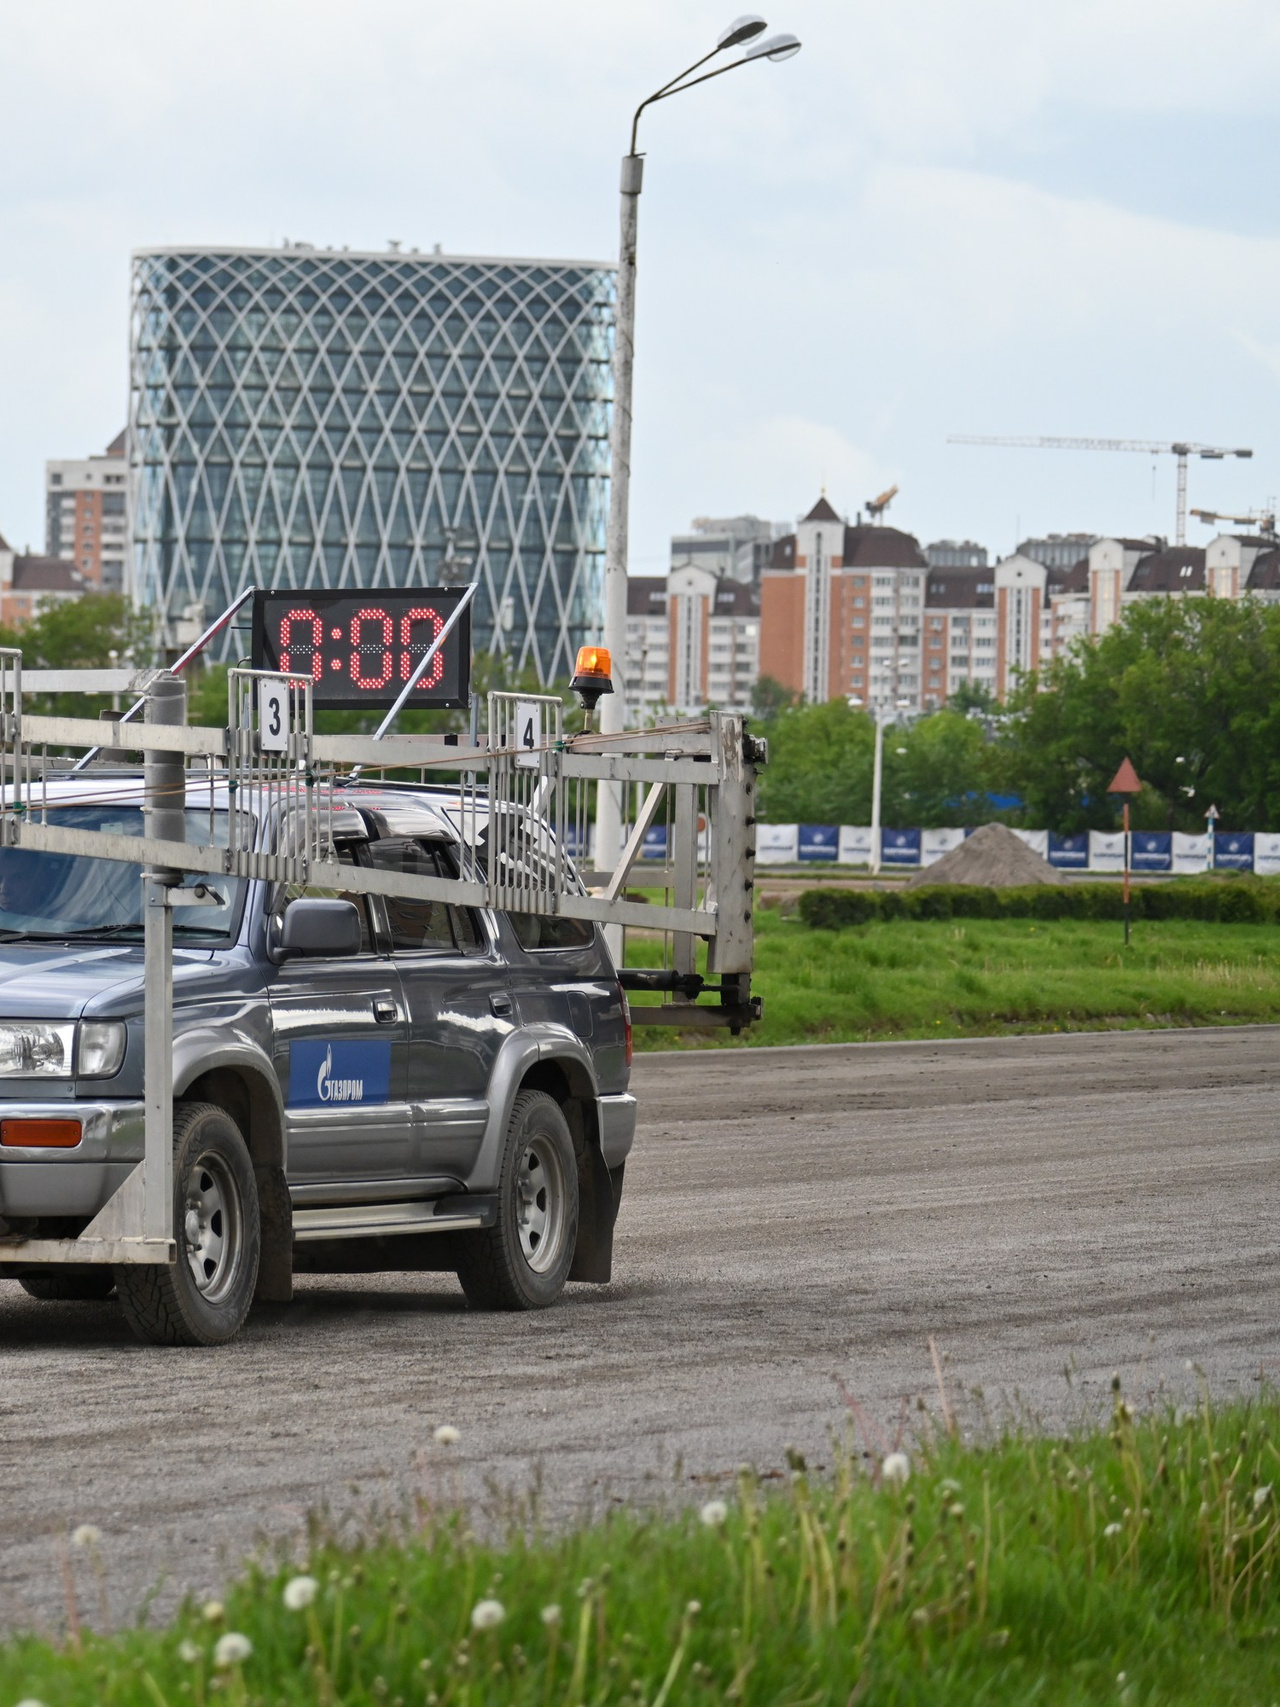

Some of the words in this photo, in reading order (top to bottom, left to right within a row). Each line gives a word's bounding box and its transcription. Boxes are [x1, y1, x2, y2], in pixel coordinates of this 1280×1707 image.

[280, 608, 444, 689] 0:00
[269, 697, 281, 736] 3
[523, 717, 535, 753] 4
[330, 1079, 363, 1101] ГАЗПРОМ
